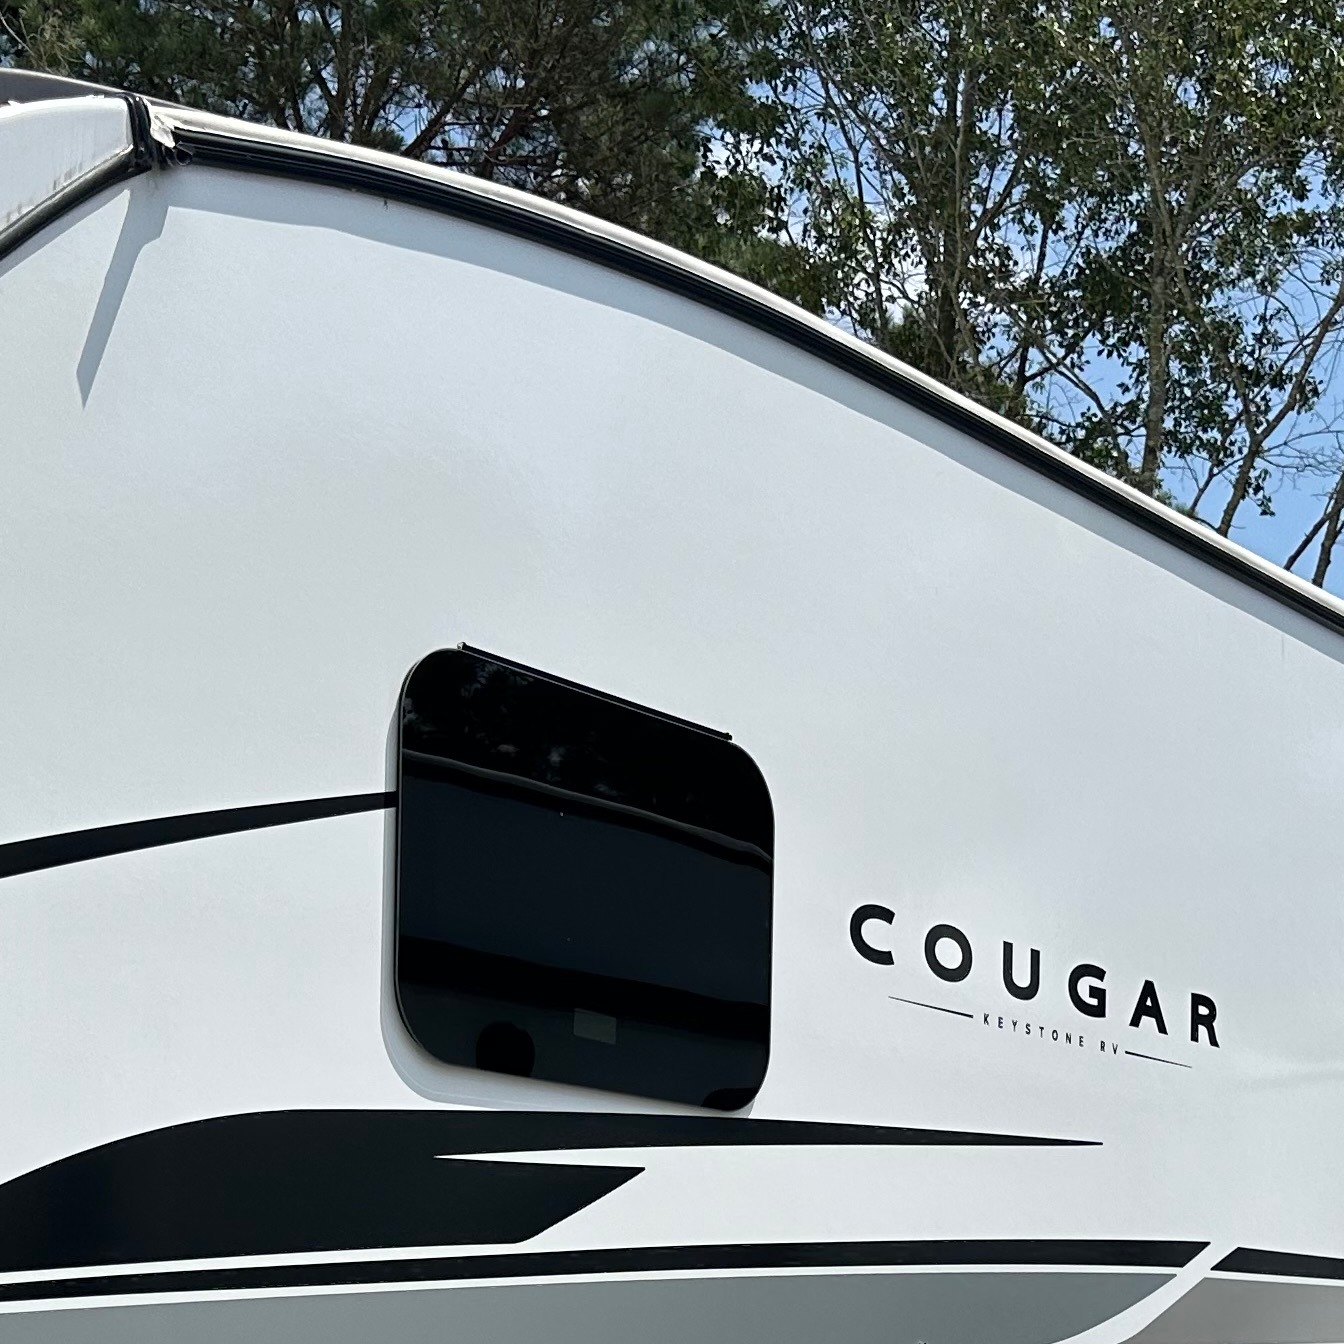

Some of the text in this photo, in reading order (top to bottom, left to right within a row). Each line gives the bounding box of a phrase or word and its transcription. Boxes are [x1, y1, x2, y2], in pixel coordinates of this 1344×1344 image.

[849, 903, 1220, 1048] COUGAR
[983, 1012, 1119, 1055] KEYSTONE RV
